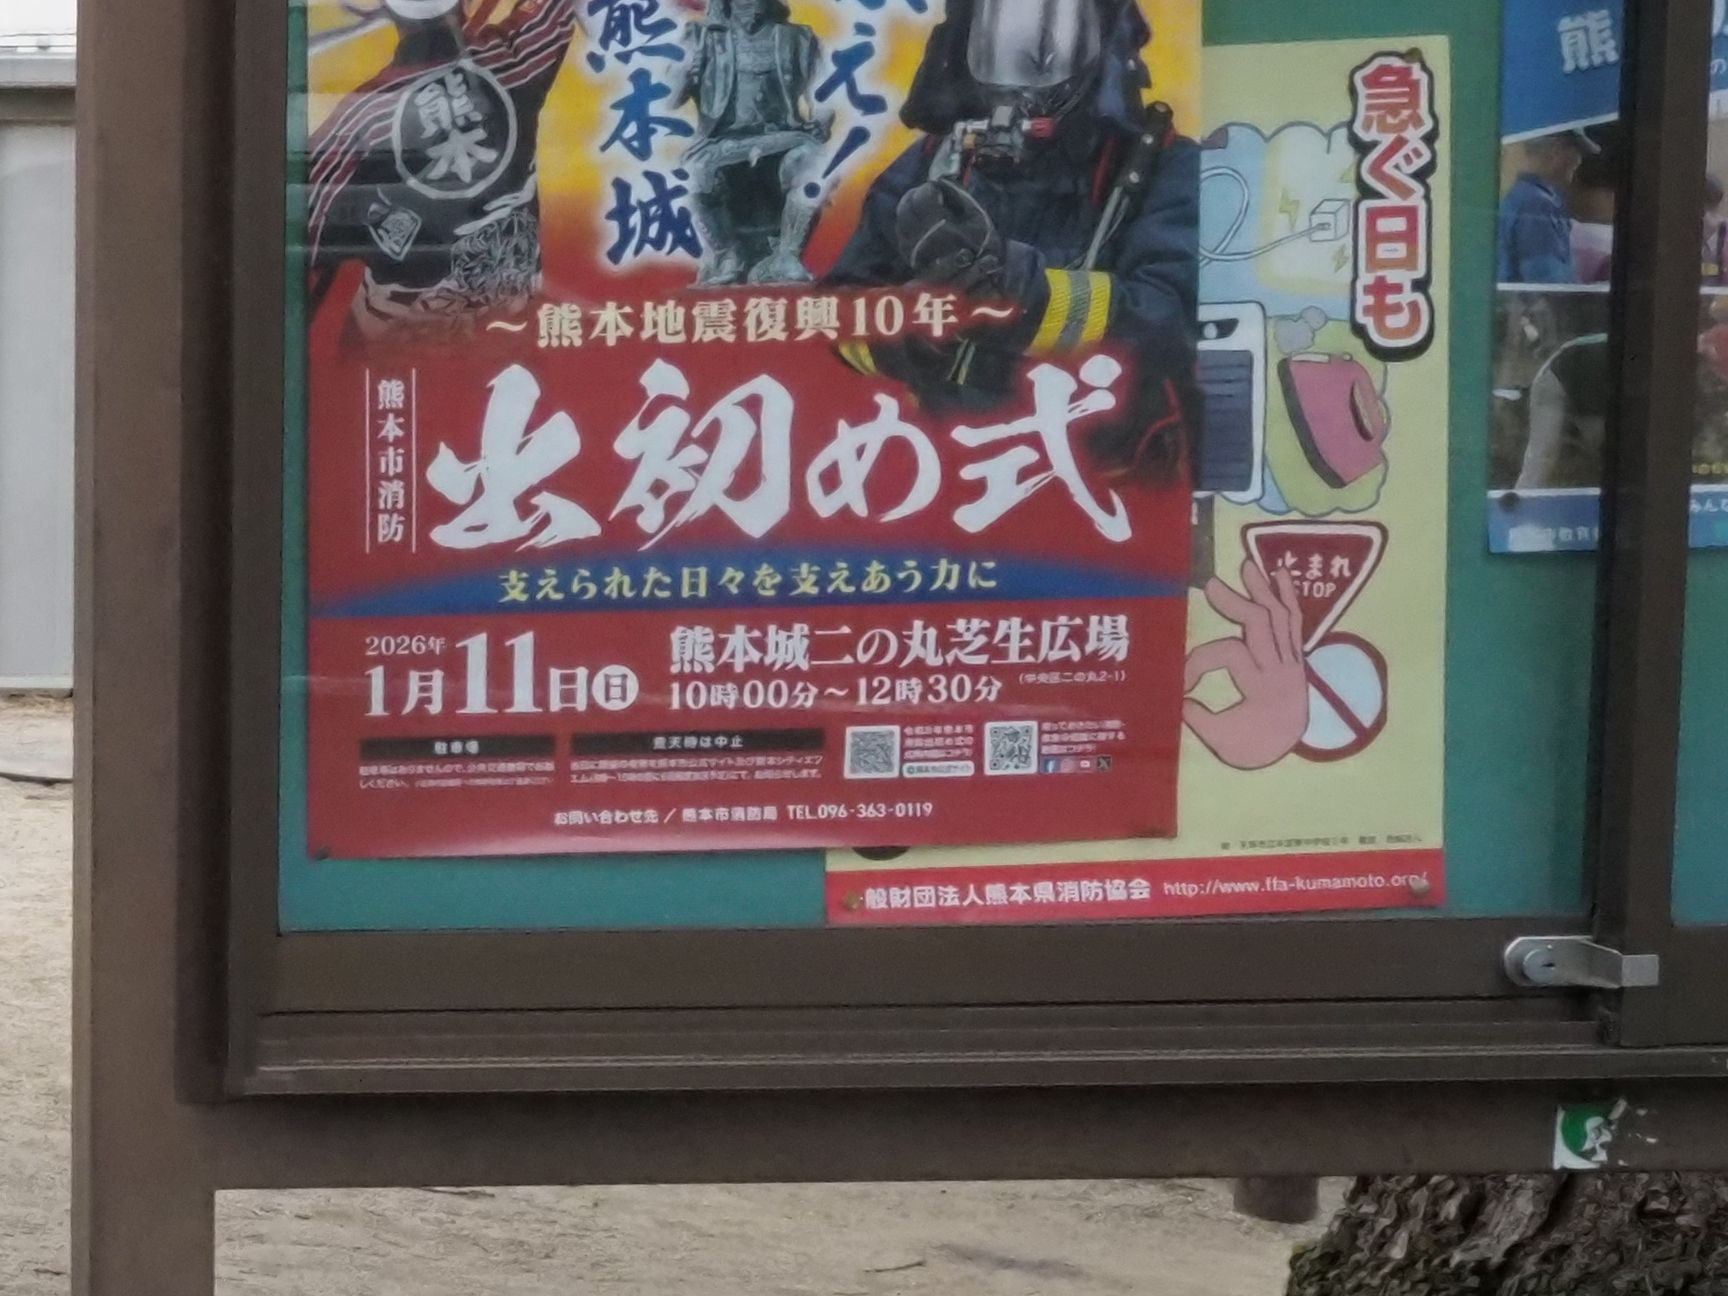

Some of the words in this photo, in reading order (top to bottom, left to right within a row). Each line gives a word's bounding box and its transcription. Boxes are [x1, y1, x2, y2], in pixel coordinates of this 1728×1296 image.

[413, 72, 500, 184] 熊本
[1353, 57, 1432, 349] 急ぐ日も
[376, 378, 406, 544] 熊本市消防
[425, 352, 1133, 552] 出初め式
[497, 558, 999, 603] 支えられた日々を支えあう力に
[1270, 550, 1352, 580] 止まれ
[364, 634, 447, 656] 2026年
[668, 613, 1132, 674] 熊本城二の丸芝生広場
[858, 877, 1152, 909] 般財団法人熊本県消防協会
